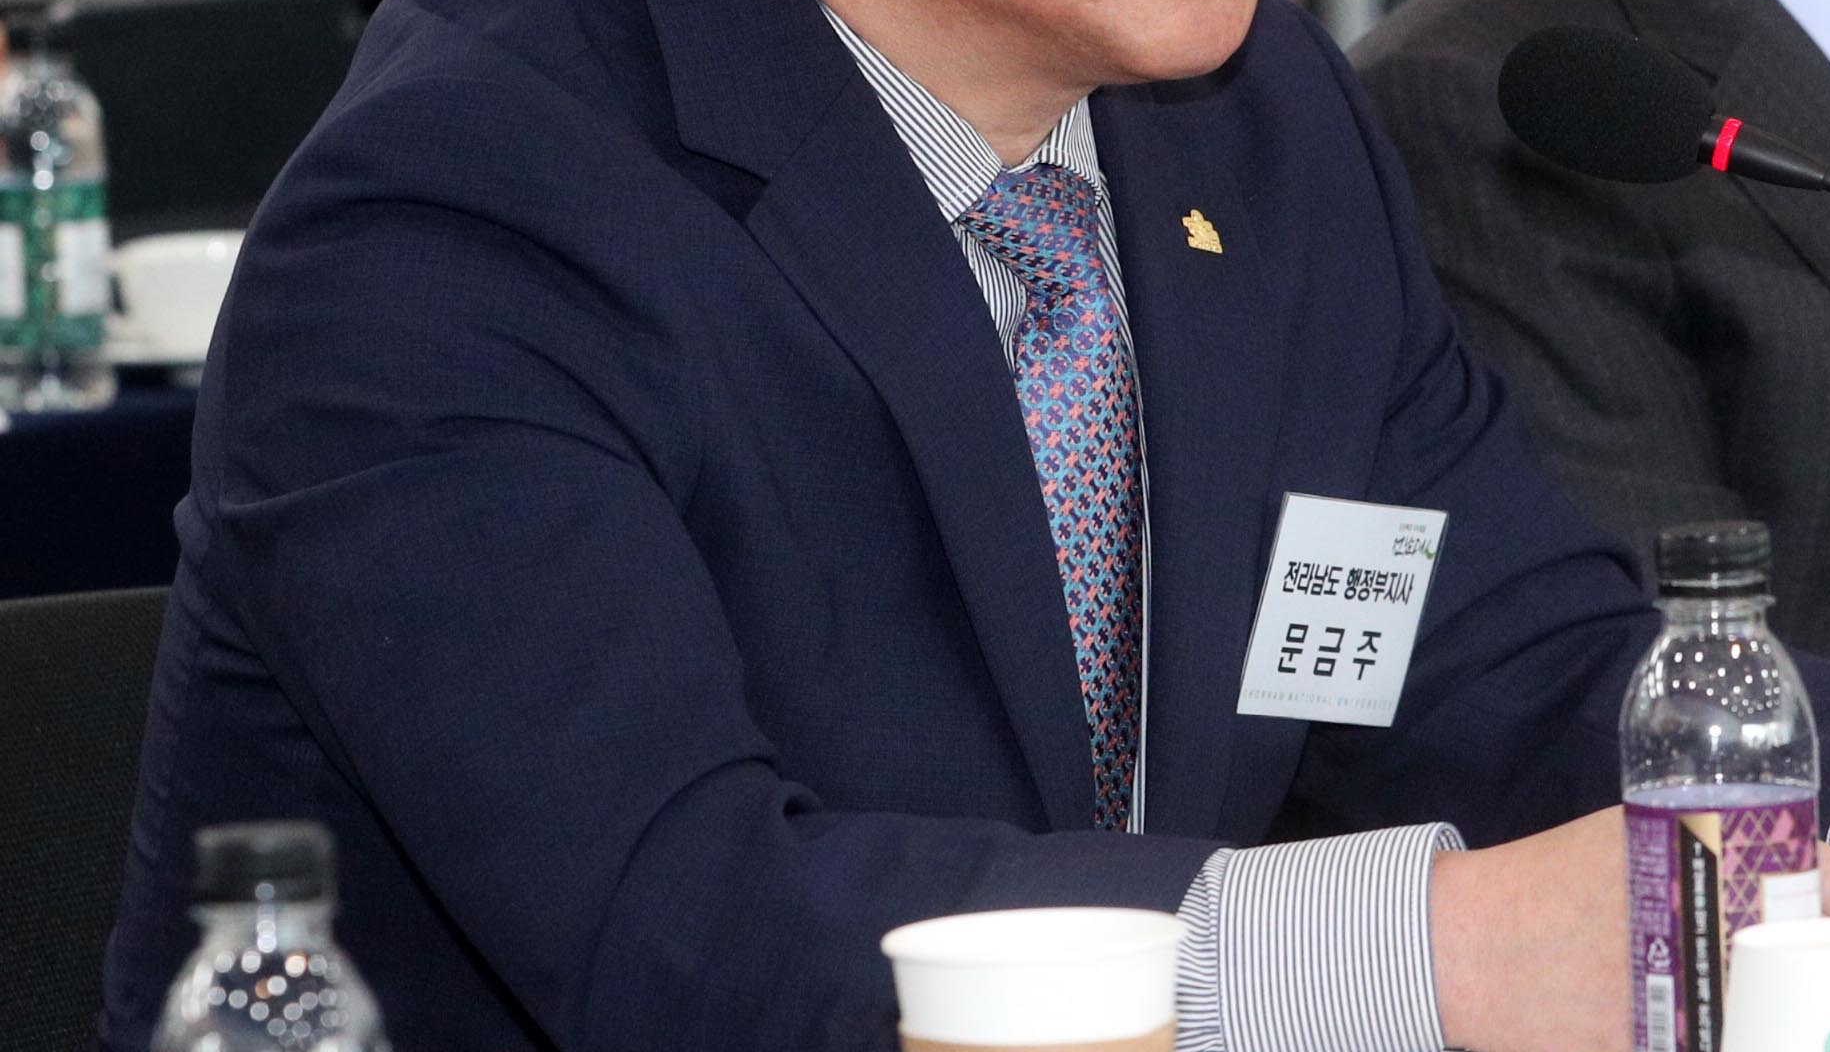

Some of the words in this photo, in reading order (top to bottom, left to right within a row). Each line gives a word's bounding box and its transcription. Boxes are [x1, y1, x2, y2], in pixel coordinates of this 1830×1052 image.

[1282, 560, 1343, 596] 전라남도
[1344, 566, 1416, 606] 행정부지사
[1277, 623, 1382, 681] 문금주
